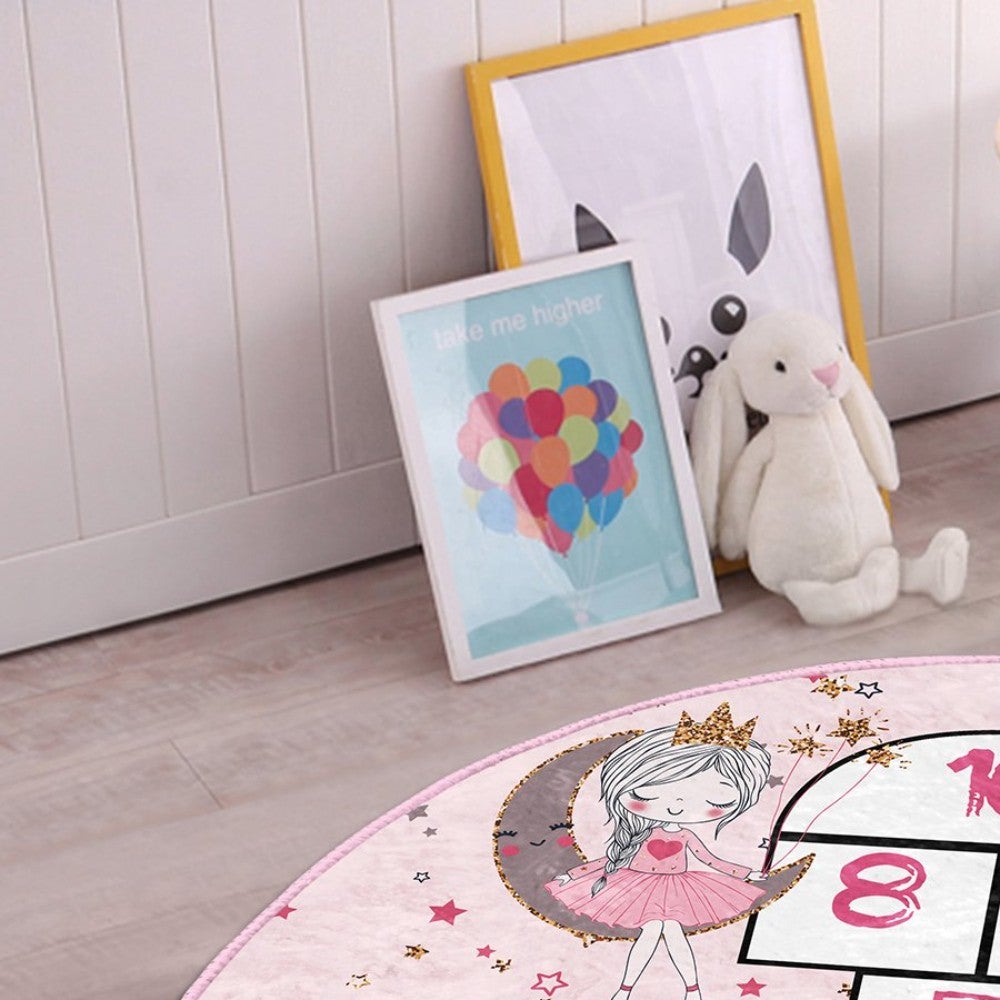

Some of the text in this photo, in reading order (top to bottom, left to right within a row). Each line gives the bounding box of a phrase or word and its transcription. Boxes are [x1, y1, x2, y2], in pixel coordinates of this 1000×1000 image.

[433, 293, 603, 350] take me higher
[832, 852, 928, 930] 8
